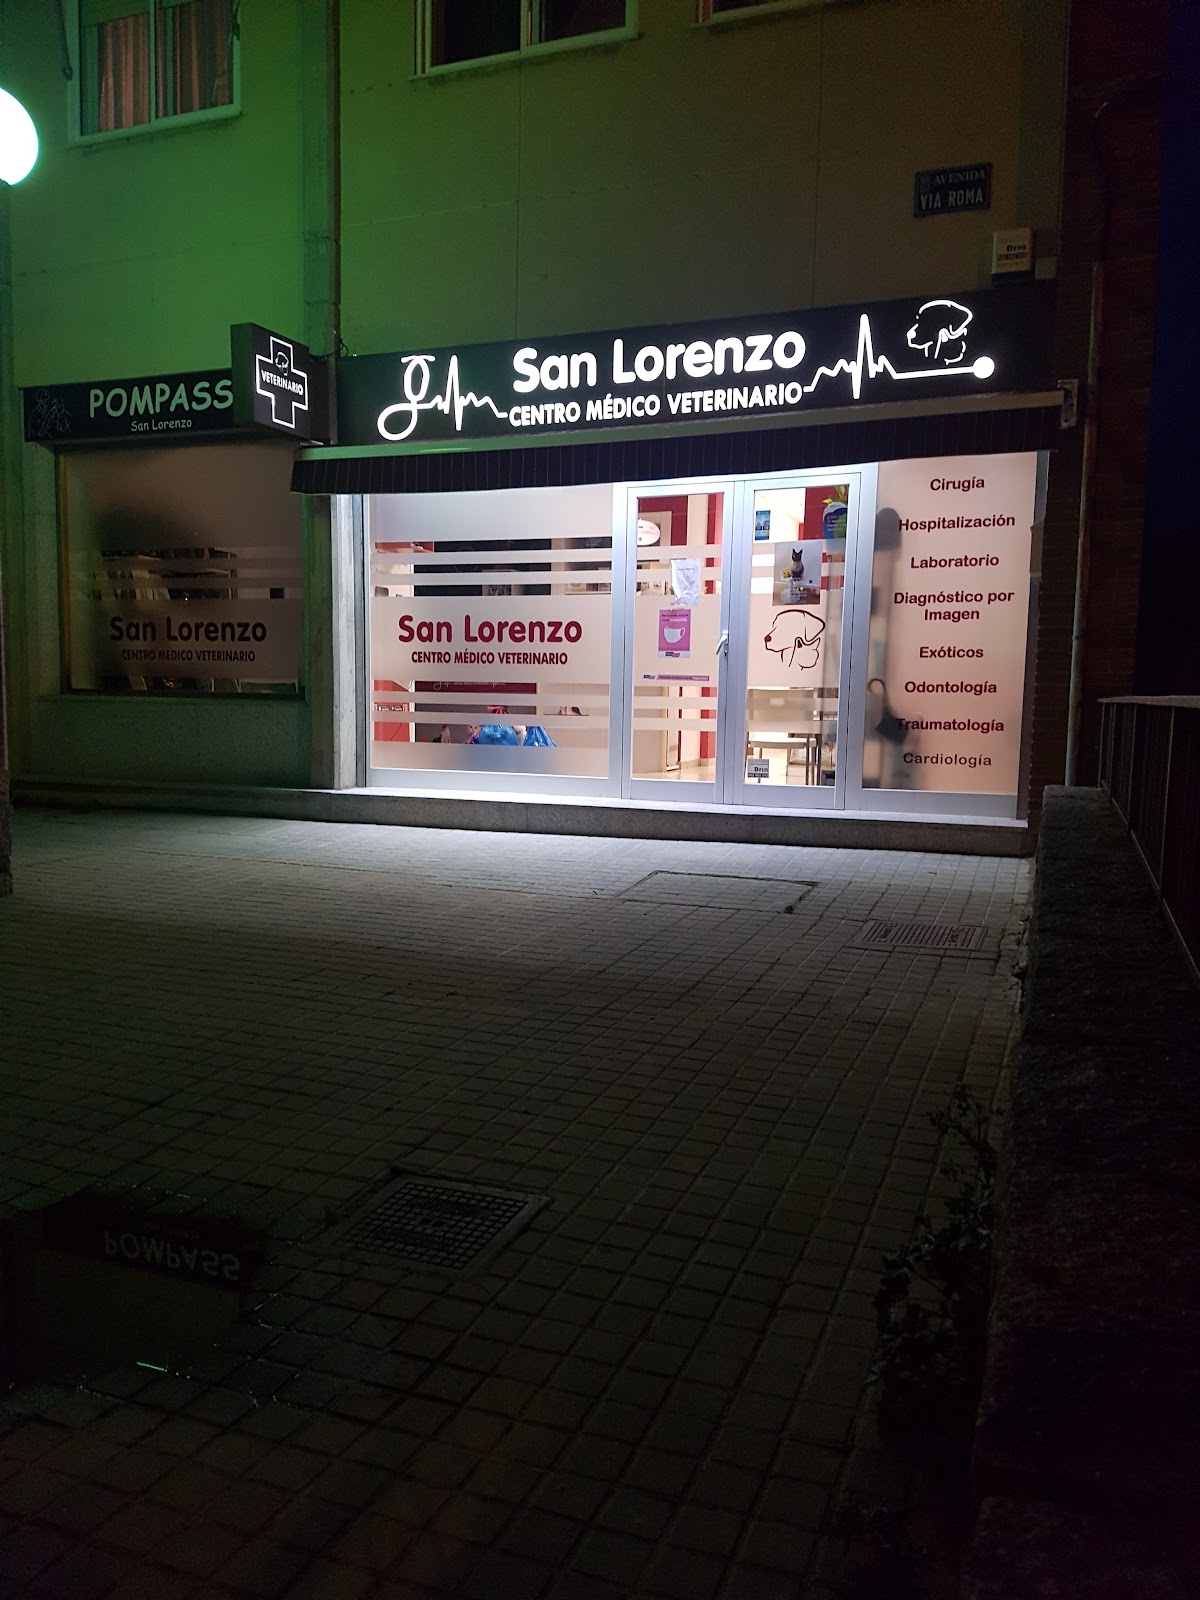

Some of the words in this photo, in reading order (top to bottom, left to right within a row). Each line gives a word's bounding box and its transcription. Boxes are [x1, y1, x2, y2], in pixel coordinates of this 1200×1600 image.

[934, 169, 986, 185] AVENIDA
[920, 192, 942, 210] VIA
[949, 187, 984, 208] ROMA
[512, 347, 598, 393] San
[612, 330, 807, 384] Lorenzo
[260, 369, 304, 396] VETERINARIO
[89, 379, 234, 419] POMPASS
[508, 401, 582, 427] CENTRO
[585, 393, 661, 422] MÉDICO
[666, 381, 803, 415] VETERINARIO
[130, 420, 150, 432] San
[152, 418, 193, 431] Lorenzo
[929, 476, 986, 493] Cirugía
[899, 514, 1016, 533] Hospitalización
[910, 554, 1000, 569] Laboratorio
[893, 591, 984, 607] Diagnóstico
[987, 592, 1015, 605] por
[924, 608, 980, 623] Imagen
[110, 616, 157, 642] San
[166, 616, 268, 642] Lorenzo
[398, 614, 453, 643] San
[464, 614, 583, 643] Lorenzo
[122, 650, 156, 661] CENTRO
[196, 650, 257, 662] VETERINARIO
[411, 651, 451, 664] CENTRO
[454, 648, 495, 664] MÉDICO
[498, 652, 568, 665] VETERINARIO
[919, 645, 984, 659] Exóticos
[904, 681, 998, 696] Odontología
[895, 718, 1005, 734] Traumatología
[903, 753, 992, 769] Cardiología
